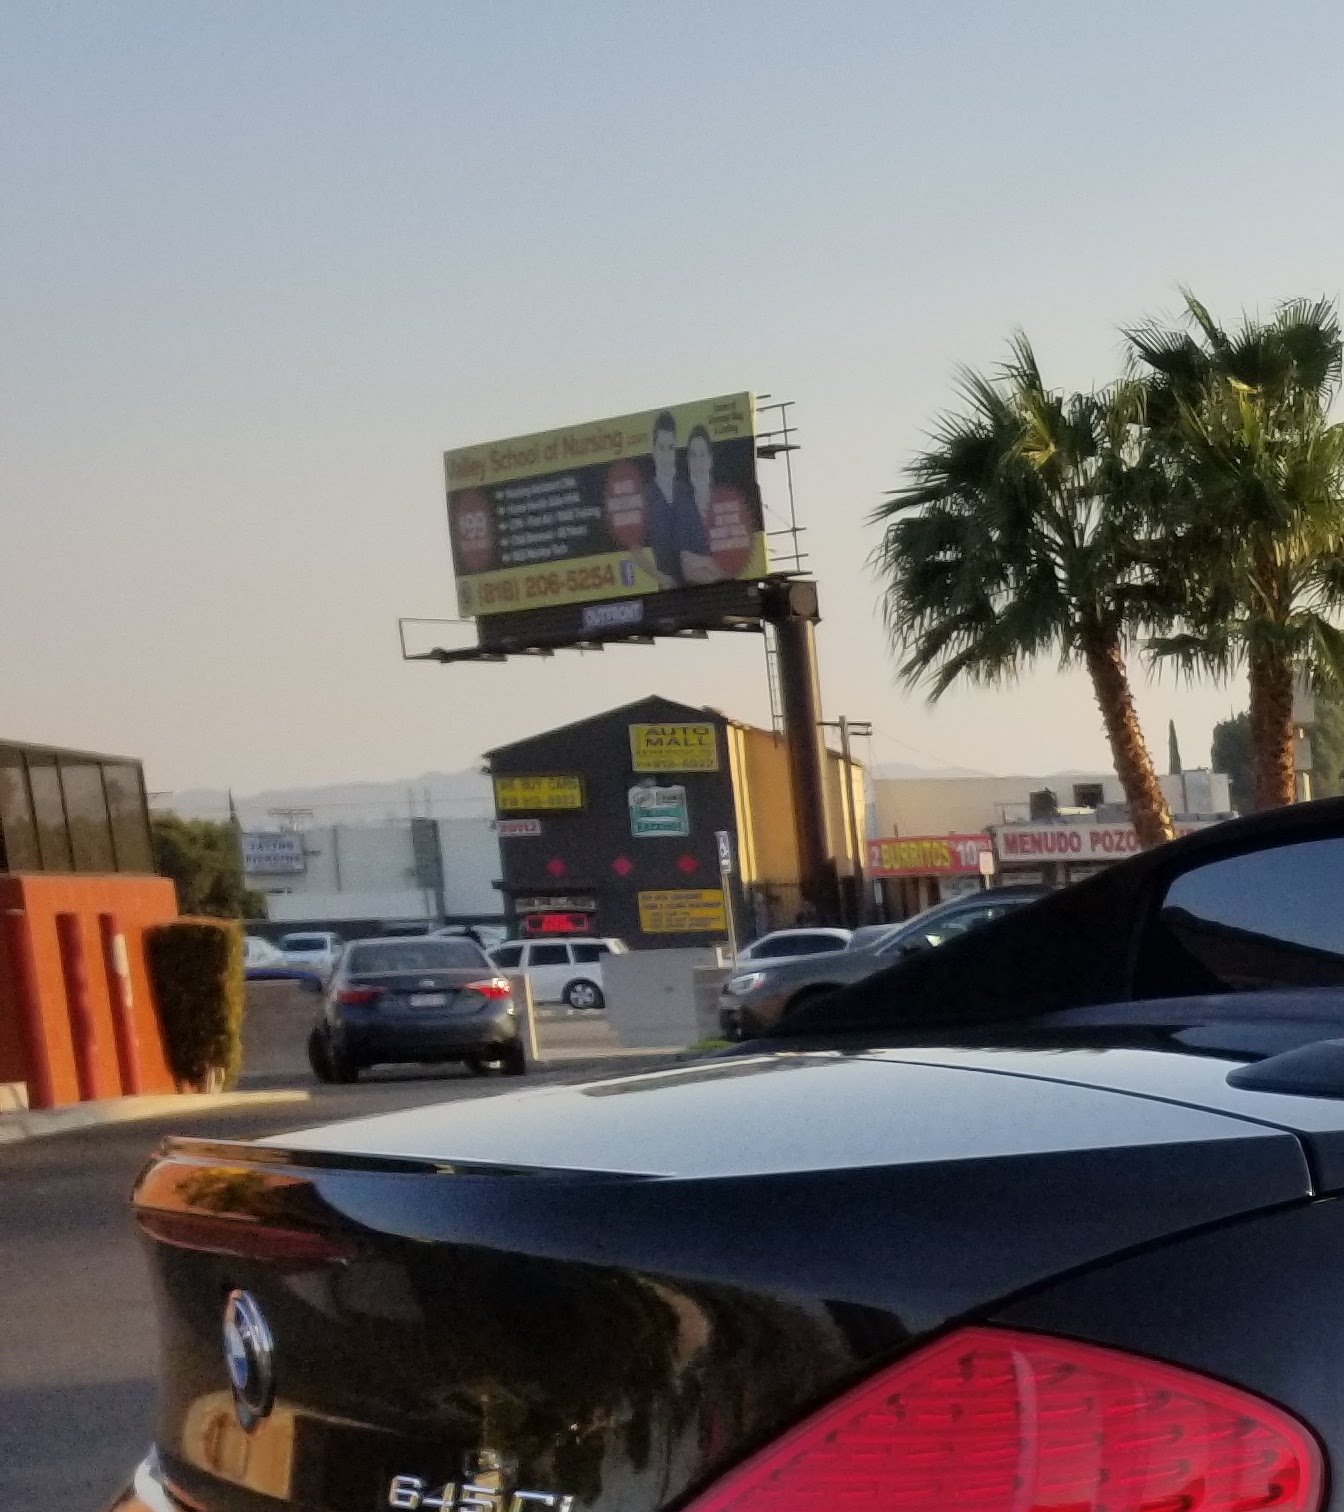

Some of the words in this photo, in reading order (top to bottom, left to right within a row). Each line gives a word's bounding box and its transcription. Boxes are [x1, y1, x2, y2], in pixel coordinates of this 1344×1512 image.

[646, 726, 709, 736] AUTO
[646, 737, 708, 747] MALL
[1003, 831, 1082, 854] MENUDO
[1089, 829, 1141, 852] POZO
